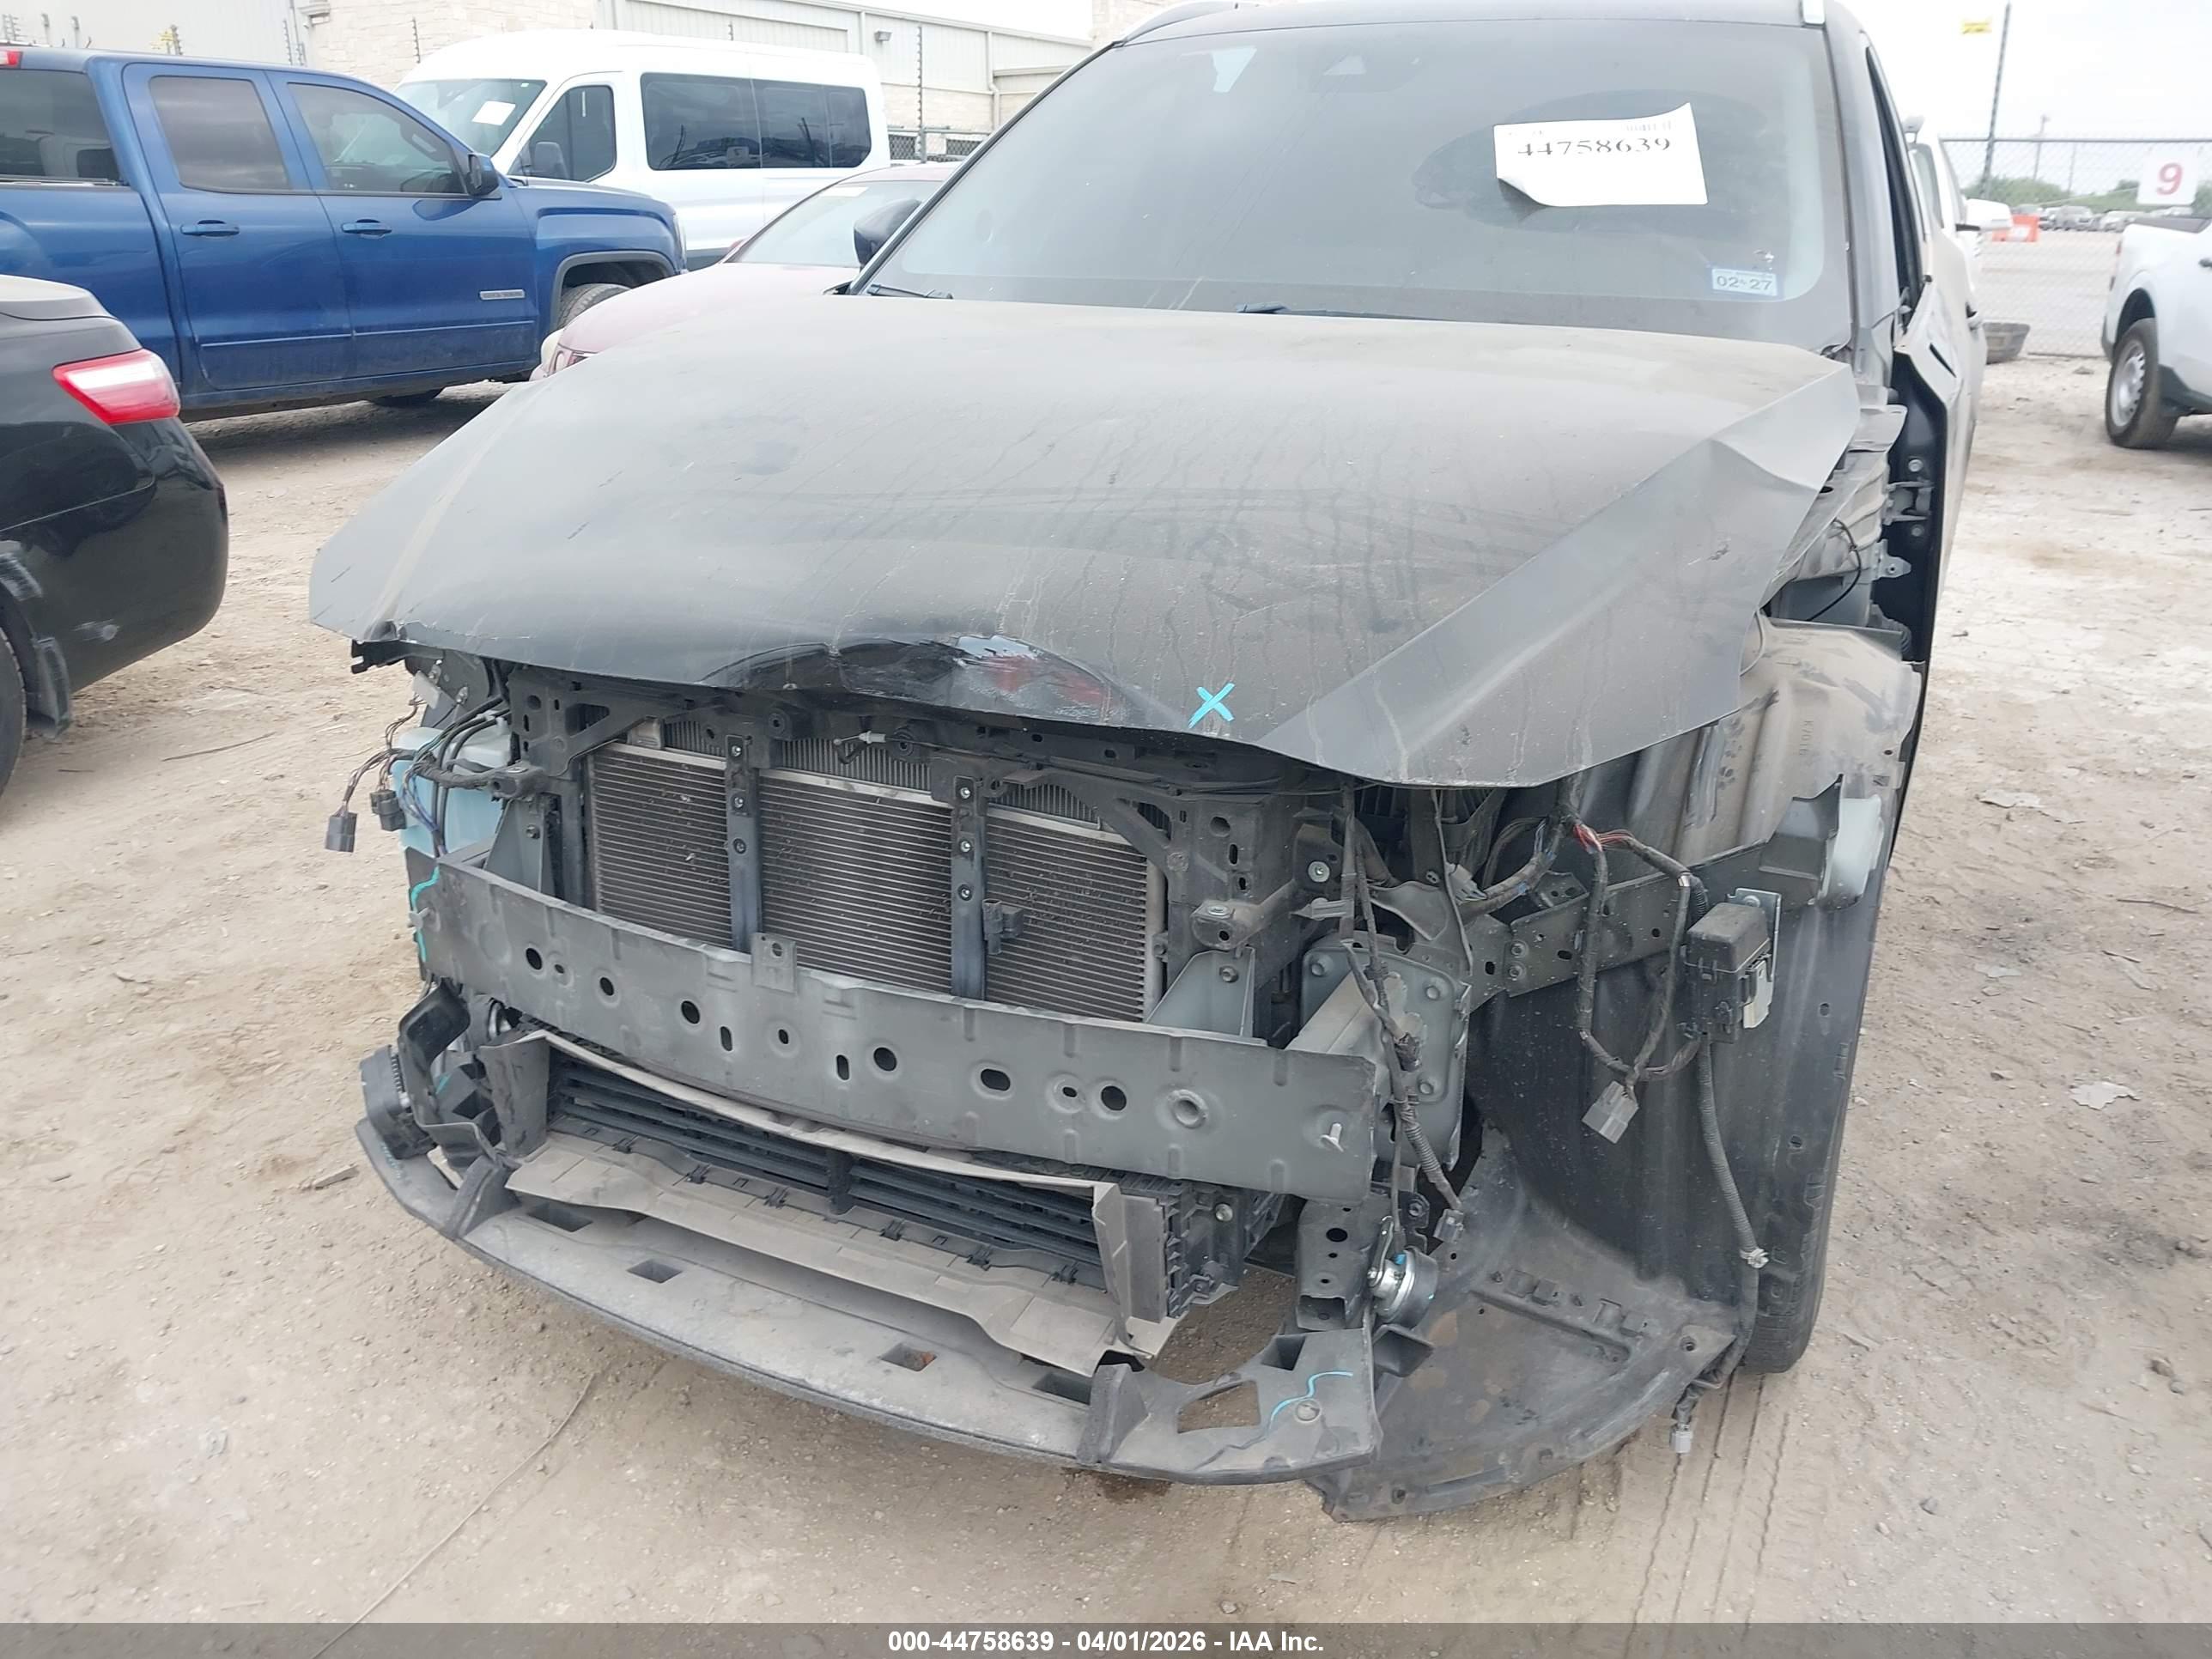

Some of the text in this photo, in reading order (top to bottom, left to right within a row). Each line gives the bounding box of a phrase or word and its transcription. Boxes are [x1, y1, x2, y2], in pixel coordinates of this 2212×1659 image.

[1517, 137, 1671, 155] 44758639
[2156, 163, 2183, 195] 9
[1717, 275, 1773, 291] 02 27
